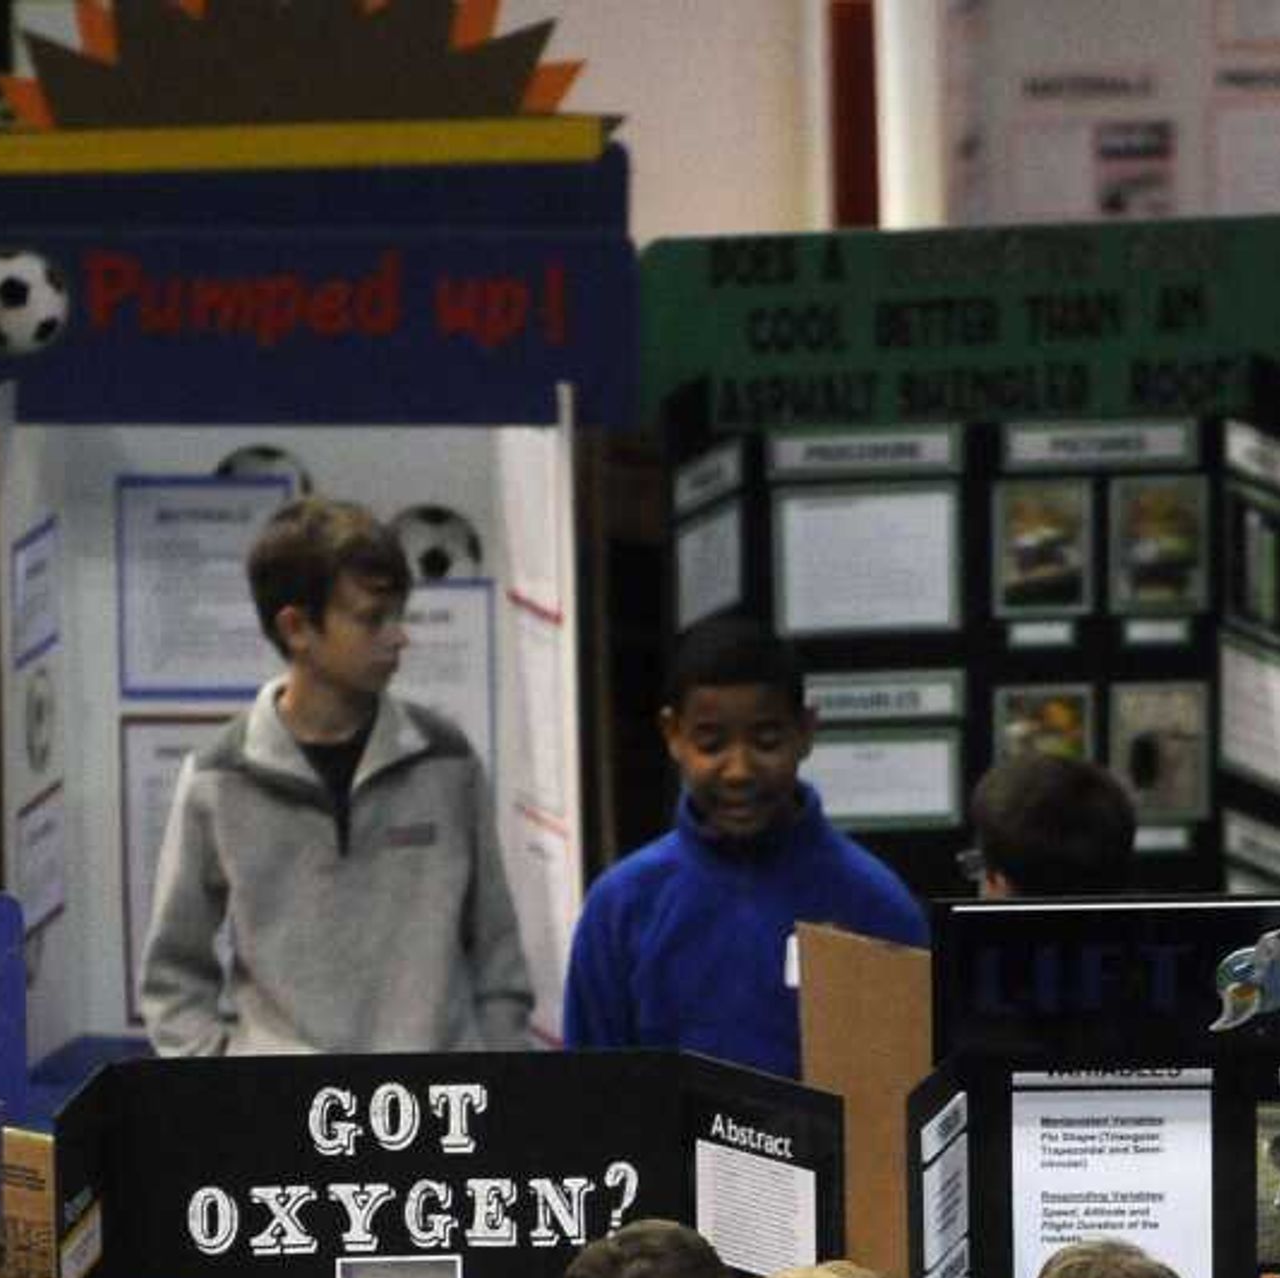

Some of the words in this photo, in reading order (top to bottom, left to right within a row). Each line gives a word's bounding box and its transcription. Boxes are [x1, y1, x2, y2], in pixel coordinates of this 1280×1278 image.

[81, 248, 404, 347] Pumped
[436, 264, 574, 347] up!
[308, 1082, 488, 1156] GOT
[710, 1112, 795, 1158] Abstract
[187, 1160, 640, 1255] OXYGEN?
